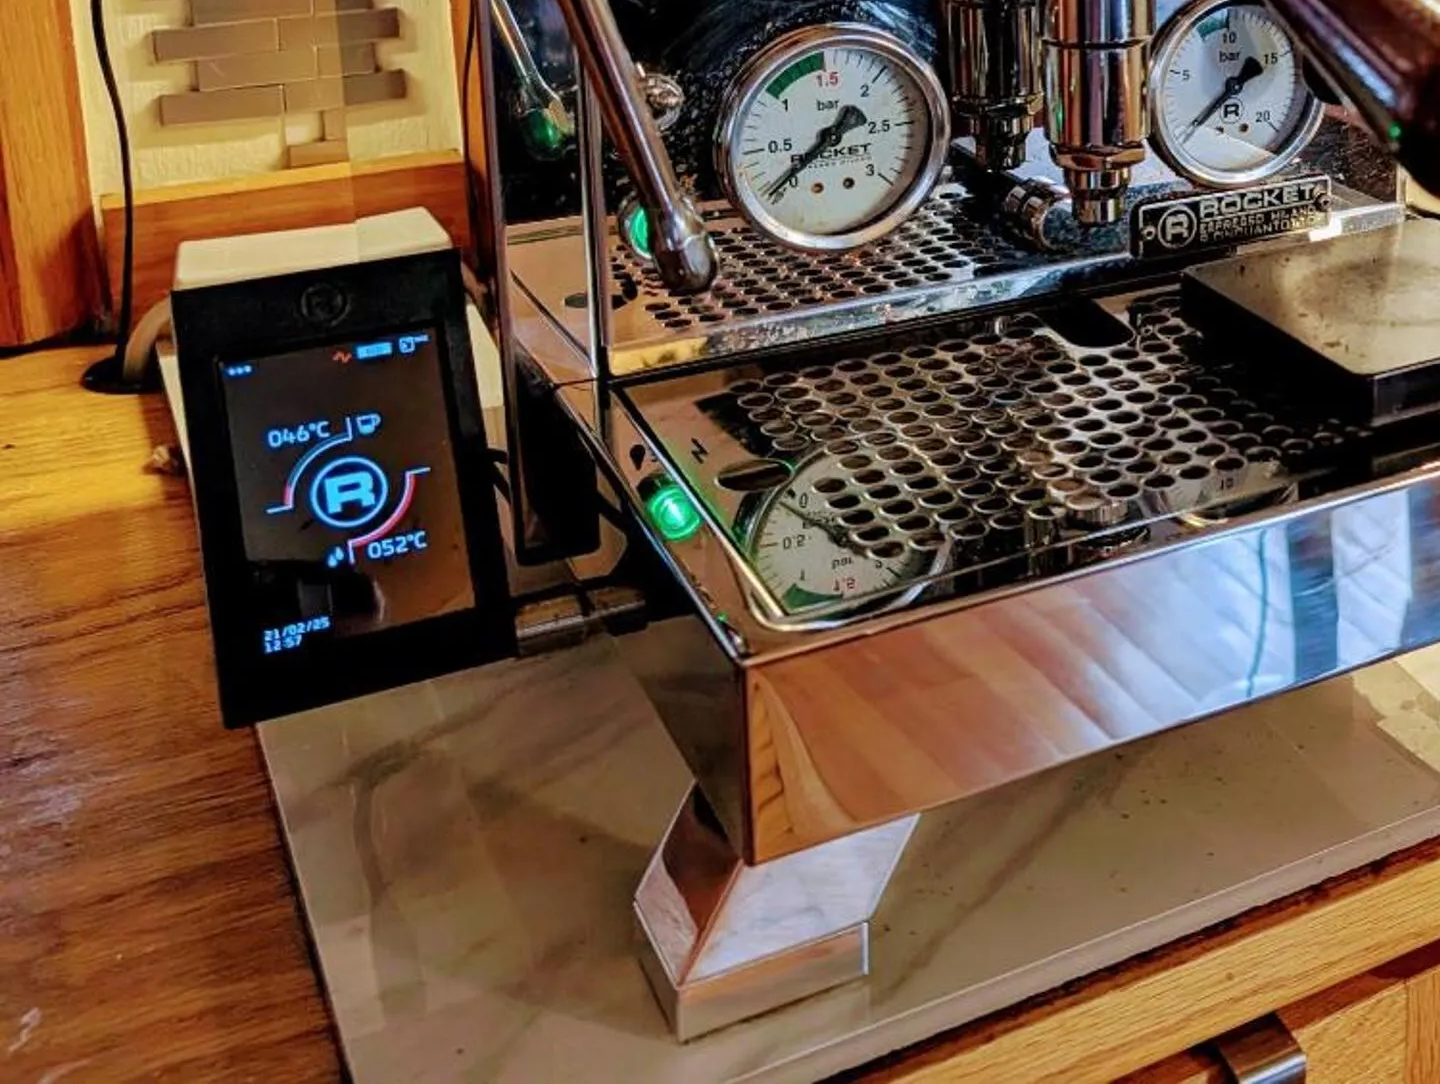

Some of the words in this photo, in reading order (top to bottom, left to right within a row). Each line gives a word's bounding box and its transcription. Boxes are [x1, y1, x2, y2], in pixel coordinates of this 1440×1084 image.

[1223, 32, 1237, 44] 10
[1219, 50, 1240, 62] bar
[1264, 53, 1278, 65] 15
[816, 72, 838, 87] 1.5
[1182, 70, 1190, 81] 5
[860, 85, 869, 97] 2
[782, 98, 788, 111] 1
[816, 99, 839, 111] bar
[1223, 104, 1239, 118] R
[1256, 110, 1270, 122] 20
[868, 120, 890, 133] 2.5
[768, 139, 792, 153] 0.5
[865, 164, 874, 176] 3
[1199, 185, 1315, 219] ROCKET
[268, 421, 330, 448] 046°C
[367, 531, 427, 559] 052°C
